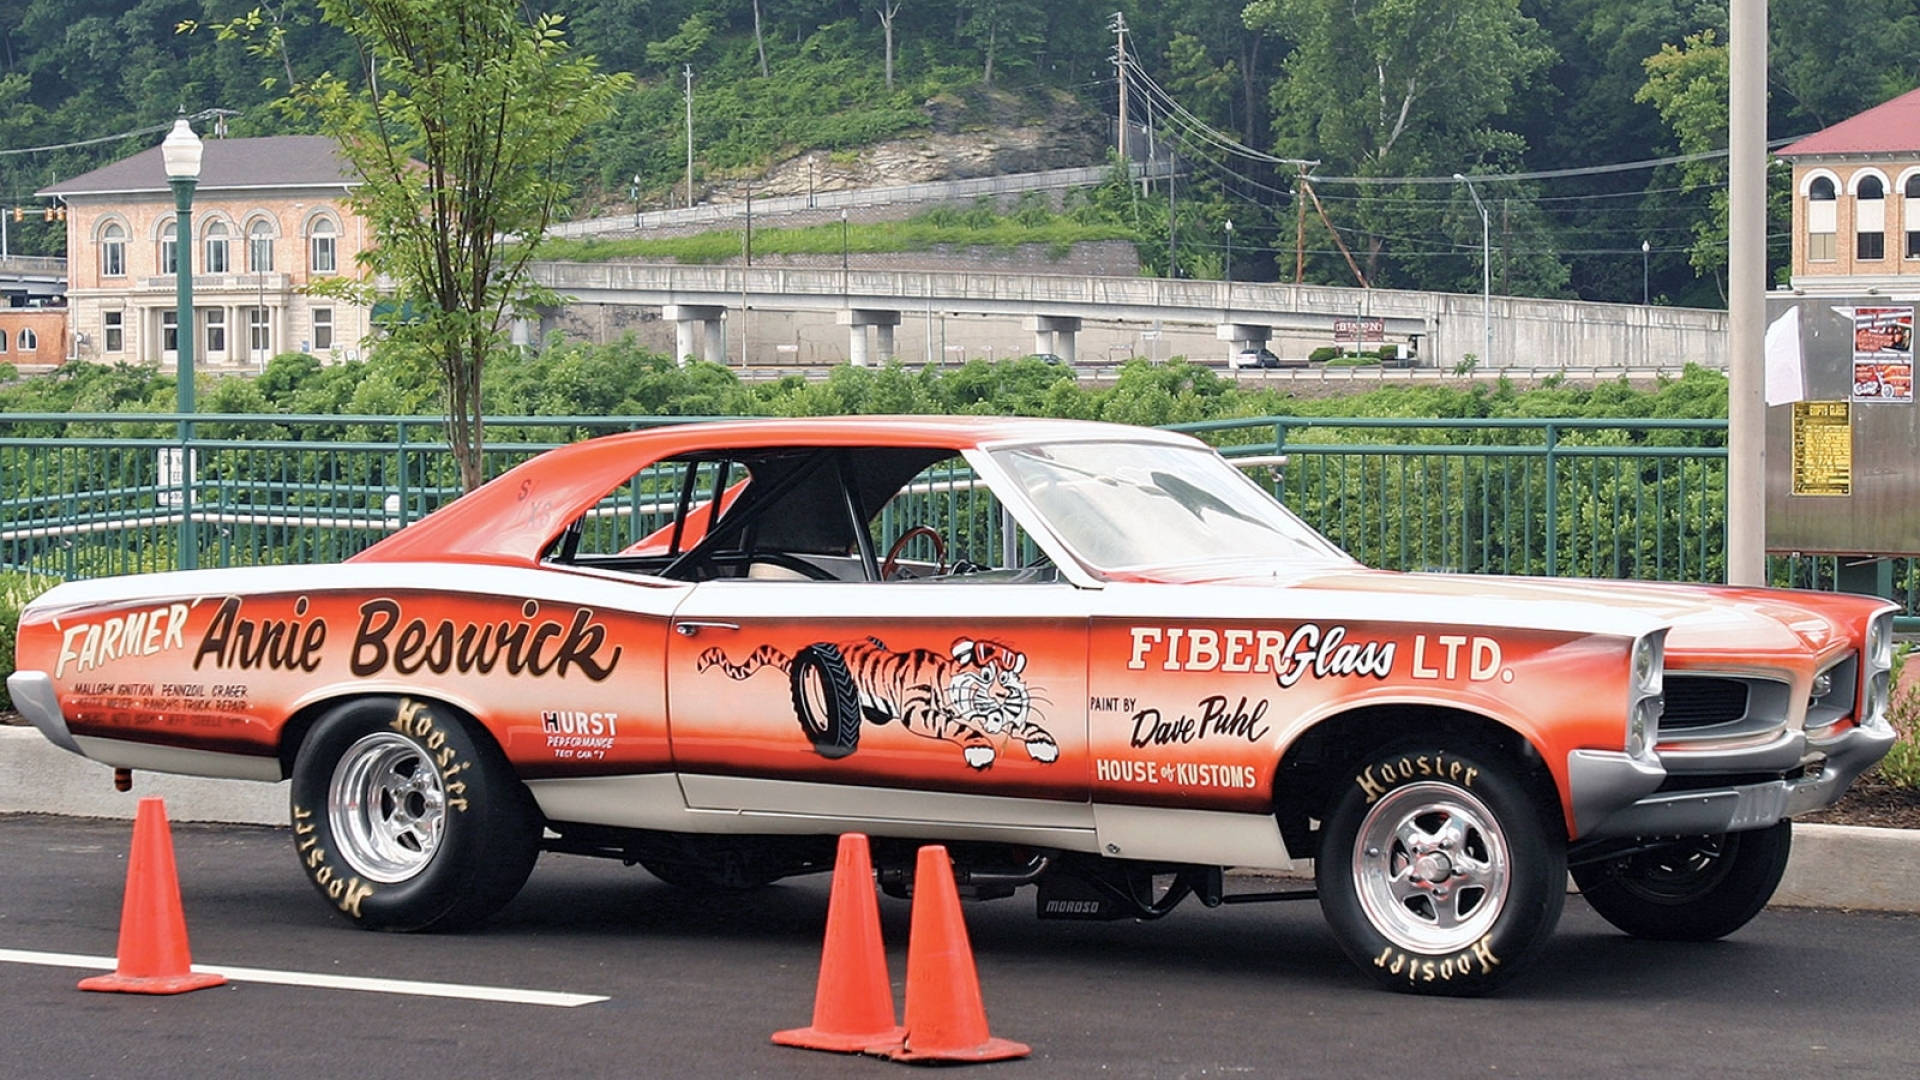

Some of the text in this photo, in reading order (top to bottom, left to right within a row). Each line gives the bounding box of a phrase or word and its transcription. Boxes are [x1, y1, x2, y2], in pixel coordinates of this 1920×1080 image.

[192, 594, 328, 673] Arnie
[350, 597, 623, 683] Beswick
[1411, 634, 1515, 684] LTD.
[75, 683, 115, 695] MALLORY
[161, 683, 205, 697] PENNZOIL
[211, 684, 249, 698] CRAGER
[1090, 696, 1137, 713] PAINT BY
[183, 699, 211, 712] TRUCK
[215, 699, 247, 713] REPAIR
[541, 710, 618, 736] HURST
[1130, 695, 1270, 749] Dave Puhl
[389, 697, 472, 813] Hoosier
[546, 735, 615, 749] PERFORMANCE
[554, 748, 575, 758] TEST
[1096, 759, 1256, 788] HOUSE of KUSTOMS
[1355, 750, 1479, 804] Hoosier
[294, 804, 374, 918] Hoosier
[1046, 900, 1100, 913] MOROSO
[1373, 934, 1501, 986] Hoosier
